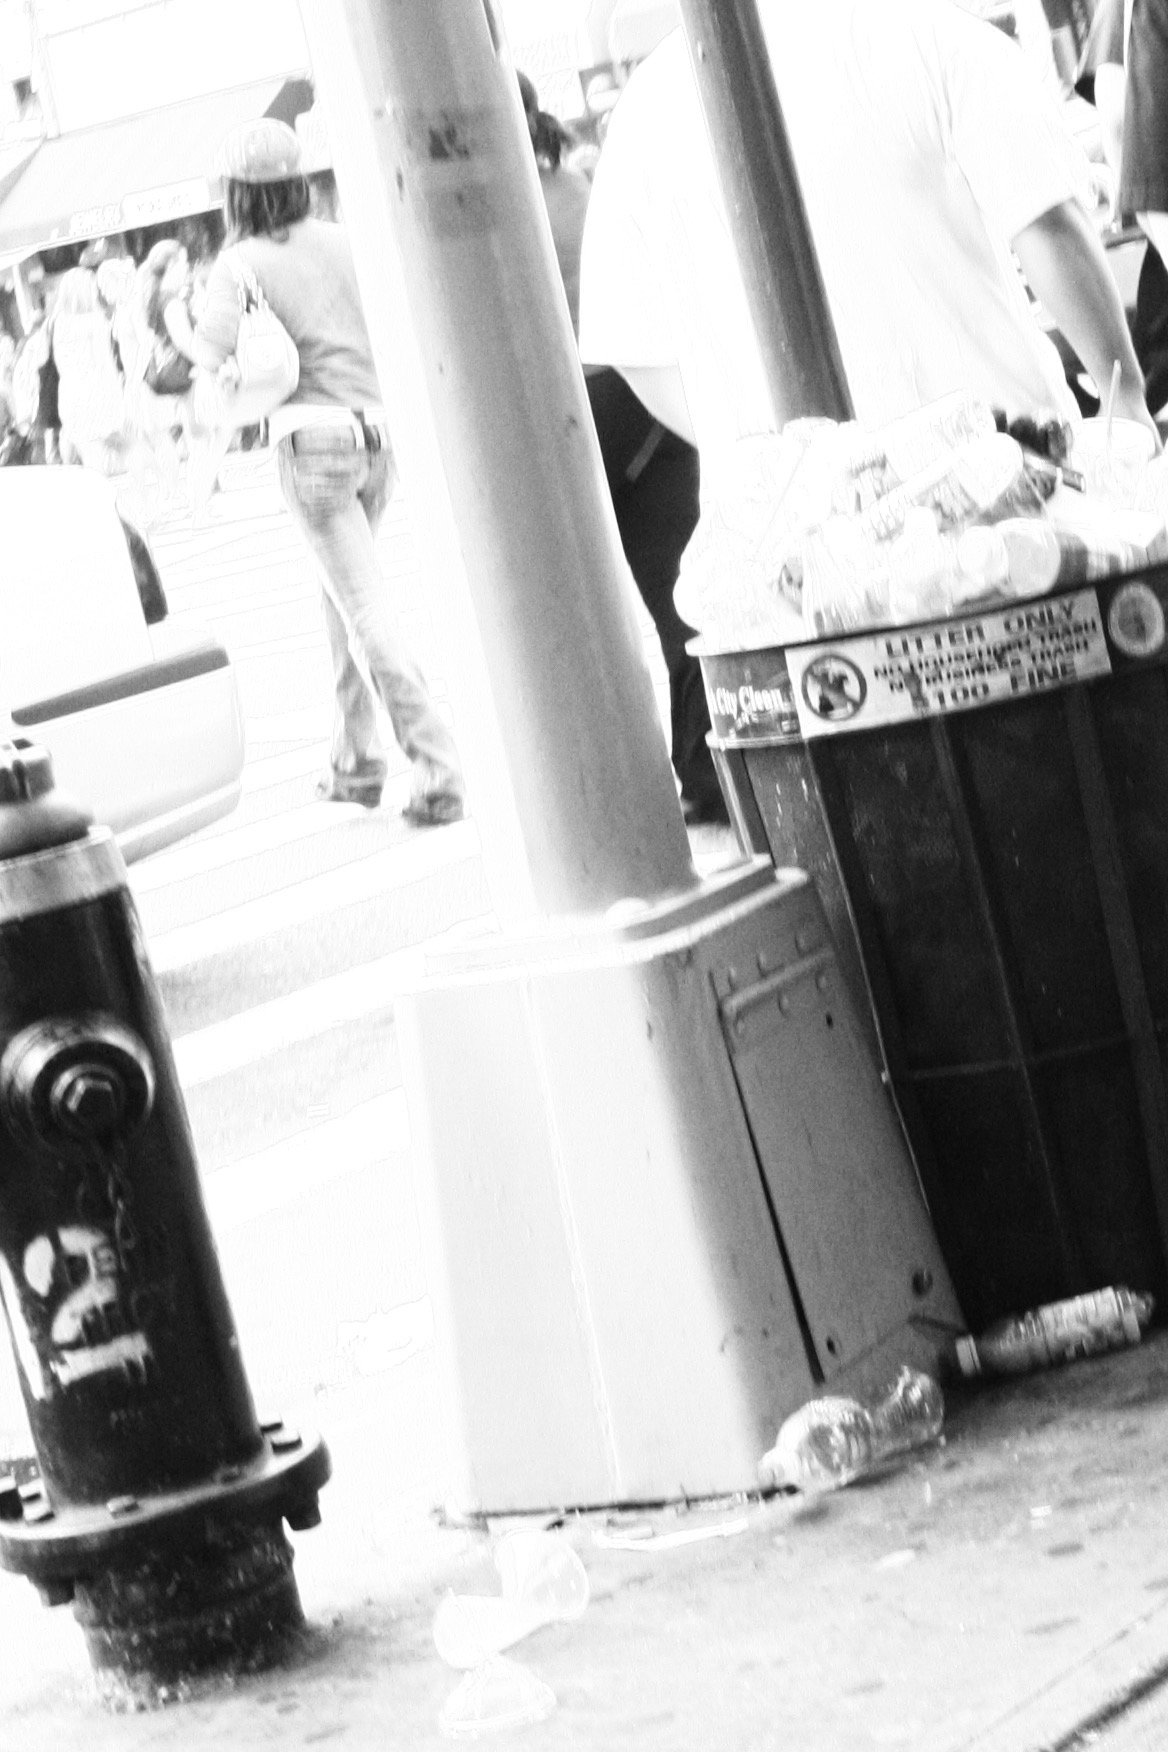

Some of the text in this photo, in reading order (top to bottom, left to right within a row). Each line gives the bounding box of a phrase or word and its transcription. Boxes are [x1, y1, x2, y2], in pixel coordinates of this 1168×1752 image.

[885, 600, 1078, 658] LITTER ONLY
[1008, 660, 1079, 692] FINE
